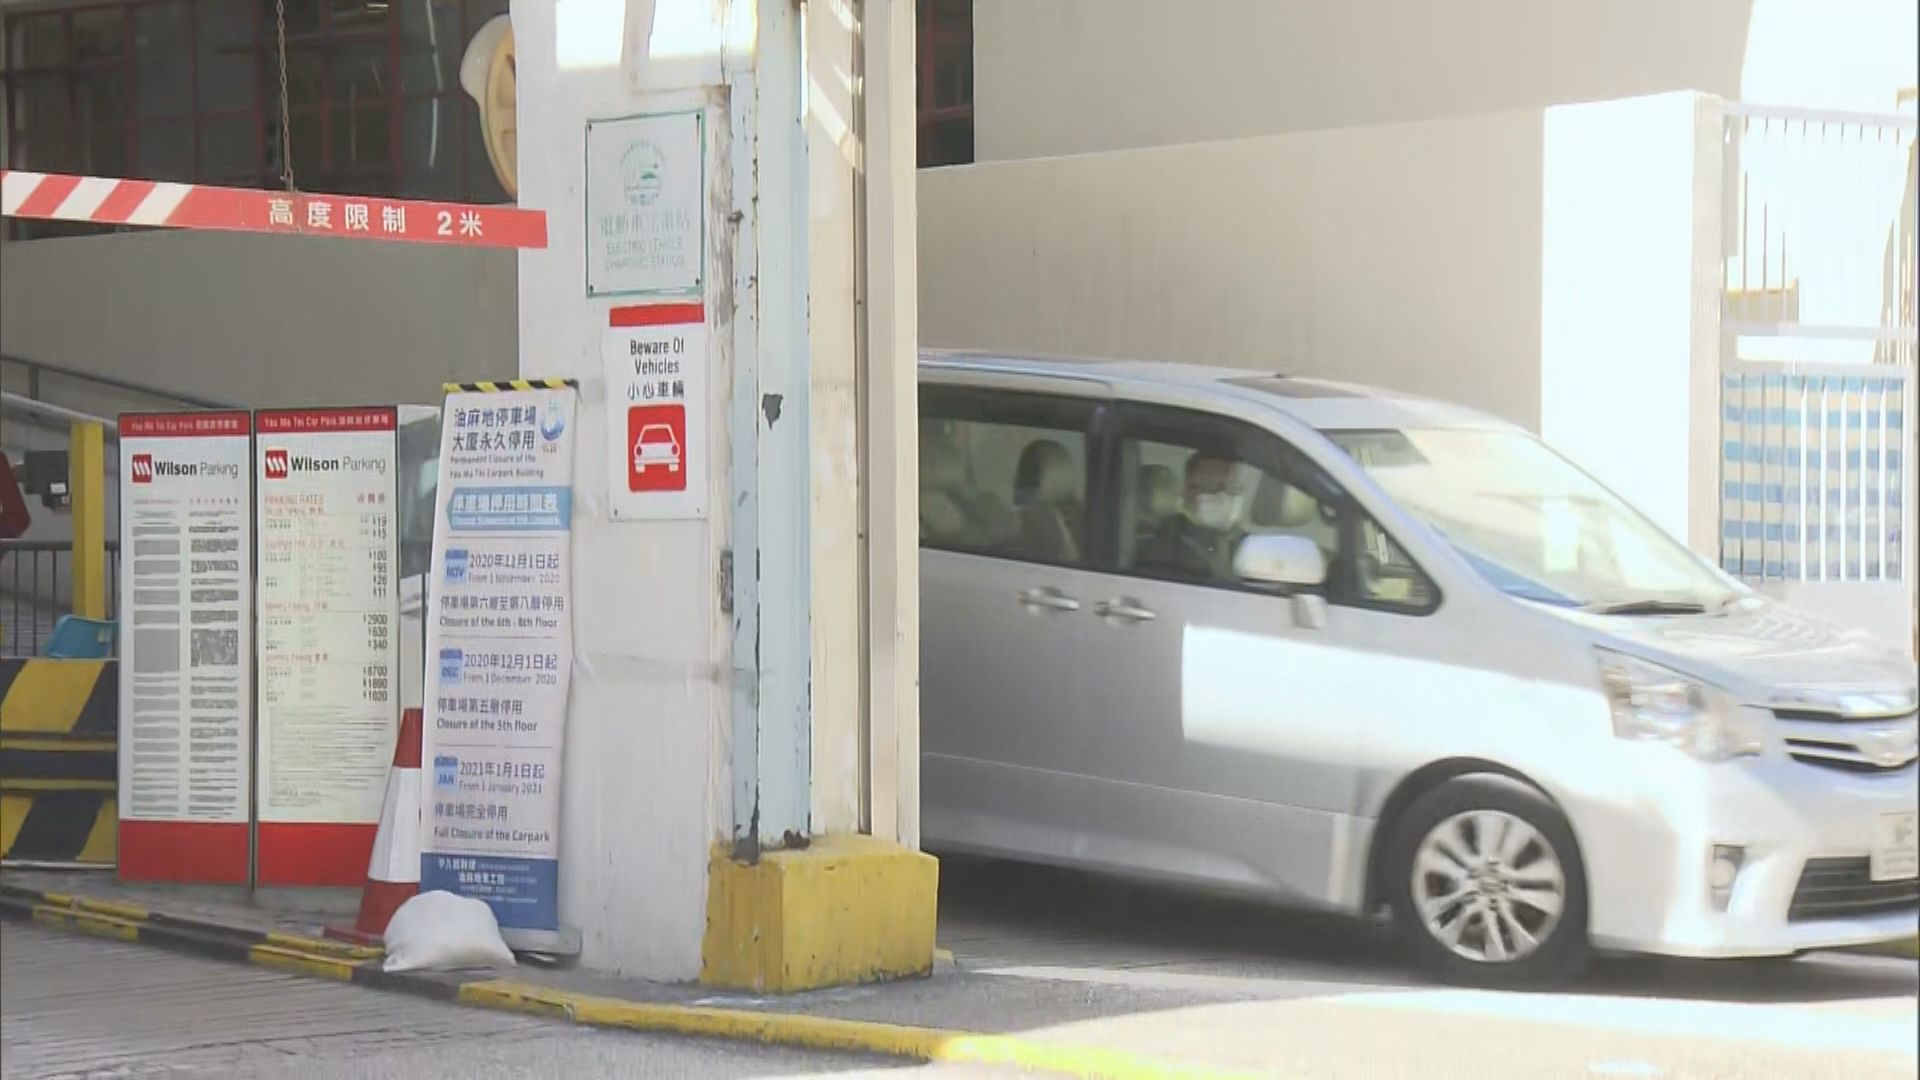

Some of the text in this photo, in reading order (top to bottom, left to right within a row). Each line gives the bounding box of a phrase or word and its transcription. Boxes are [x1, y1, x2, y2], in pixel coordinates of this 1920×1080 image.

[268, 198, 483, 237] 高度限制 2米
[630, 337, 684, 355] Beware Of
[635, 357, 679, 375] Vehicles
[628, 381, 684, 400] 小心車輛
[454, 406, 536, 427] 油麻地停車場
[452, 430, 535, 451] 大廈永久停用
[291, 456, 386, 473] Wilson Parking
[450, 455, 487, 463] Permanent
[489, 455, 514, 463] Closure
[516, 455, 523, 463] of
[154, 460, 238, 479] Wilson Parking
[469, 554, 559, 569] 2020年11月1日起
[446, 567, 465, 578] NOV
[539, 574, 560, 584] 2020
[440, 616, 469, 627] Closure
[470, 616, 479, 627] of
[481, 616, 495, 627] the
[535, 616, 558, 628] floor
[464, 654, 558, 670] 2020年12月1日起
[441, 667, 459, 678] DEC
[464, 672, 483, 682] From
[491, 673, 531, 684] December
[535, 674, 557, 685] 2020
[437, 718, 538, 732] Closure of the 5th floor
[459, 762, 545, 779] 2021年1月1日起
[437, 774, 455, 785] JAN
[459, 781, 478, 792] From
[488, 782, 519, 795] January
[521, 783, 542, 794] 2021
[434, 803, 508, 821] 停車場完全停用
[434, 826, 550, 845] Full Closure of the Carpark
